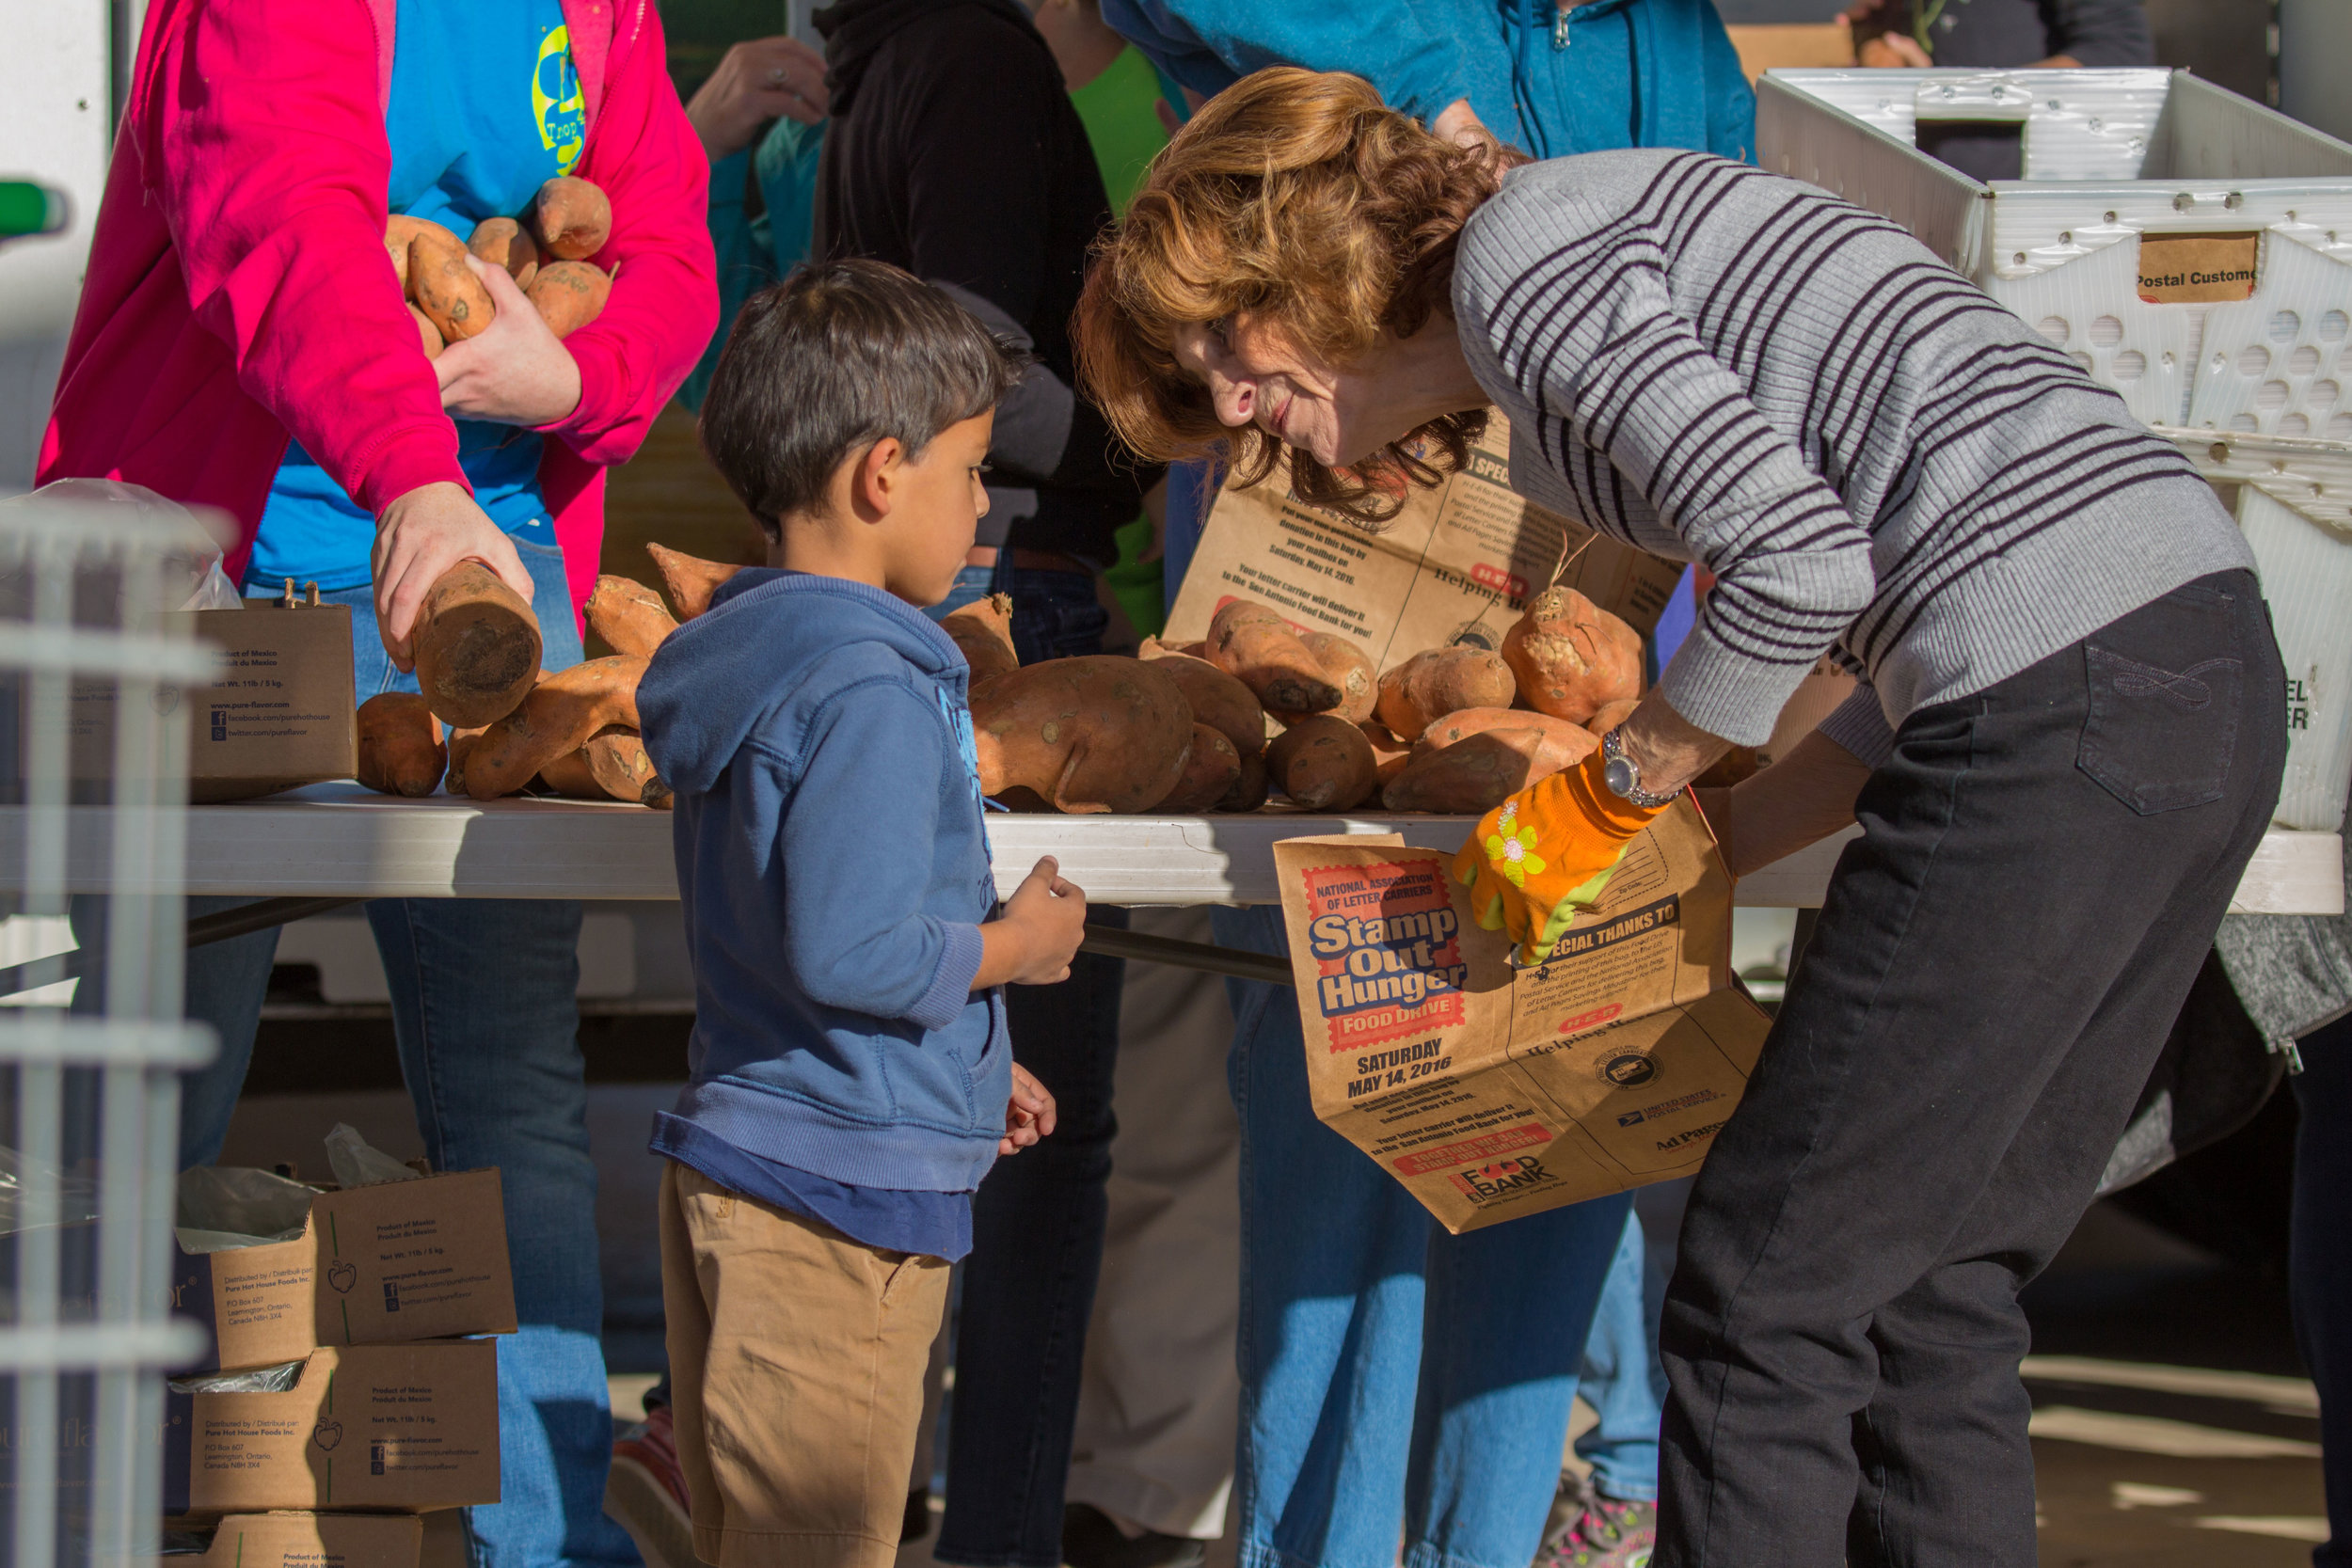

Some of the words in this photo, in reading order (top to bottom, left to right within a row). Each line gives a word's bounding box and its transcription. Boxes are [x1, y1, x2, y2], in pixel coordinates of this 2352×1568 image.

[2137, 272, 2185, 287] Postal
[1279, 519, 1314, 539] donation
[1316, 531, 1323, 542] in
[1325, 534, 1339, 548] this
[1340, 543, 1356, 556] bag
[1356, 548, 1367, 560] by
[1287, 537, 1306, 548] your
[1306, 545, 1337, 563] mailbox
[1338, 557, 1348, 567] on
[1306, 559, 1324, 573] May
[1239, 562, 1258, 578] Your
[1258, 571, 1281, 587] letter
[1282, 582, 1311, 599] carrier
[1312, 594, 1328, 607] will
[1328, 599, 1358, 617] deliver
[1359, 611, 1365, 622] it
[1435, 568, 1502, 608] Helping
[1222, 570, 1232, 580] to
[1232, 574, 1247, 586] the
[1248, 581, 1264, 594] San
[1264, 588, 1297, 609] Antonio
[1297, 601, 1317, 617] Food
[1318, 610, 1340, 626] Bank
[1341, 619, 1353, 630] for
[1354, 626, 1373, 640] you!
[1317, 880, 1367, 898] NATIONAL
[1370, 873, 1434, 888] ASSOCIATION
[1327, 899, 1341, 911] OF
[1344, 892, 1381, 908] LETTER
[1384, 884, 1433, 901] CARRIERS
[1312, 908, 1458, 954] Stamp
[1597, 913, 1654, 944] THANKS
[1655, 904, 1675, 924] TO
[1348, 940, 1435, 977] Out
[1520, 989, 1543, 1000] Postal
[1544, 982, 1569, 993] Service
[1599, 960, 1631, 975] National
[1632, 945, 1673, 965] Association
[1561, 967, 1590, 981] printing
[1321, 963, 1466, 1011] Hunger
[1535, 994, 1558, 1005] Letter
[1558, 985, 1586, 997] Carriers
[1343, 1013, 1392, 1034] FOOD
[1397, 999, 1450, 1023] DRIVE
[1358, 1037, 1442, 1074] SATURDAY
[1526, 1028, 1607, 1057] Helping
[1348, 1075, 1382, 1099] MAY
[1386, 1069, 1406, 1087] 14,
[1410, 1056, 1452, 1080] 2016
[1364, 1098, 1403, 1113] donation
[1386, 1105, 1406, 1114] your
[1406, 1094, 1442, 1107] mailbox
[1420, 1103, 1440, 1112] May
[1644, 1099, 1678, 1114] UNITED
[1679, 1089, 1711, 1104] STATES
[1646, 1106, 1681, 1120] POSTAL
[1683, 1094, 1719, 1109] SERVICE
[1375, 1135, 1398, 1145] Your
[1396, 1129, 1423, 1139] letter
[1423, 1120, 1455, 1132] carrier
[1455, 1114, 1474, 1124] will
[1473, 1106, 1505, 1119] deliver
[1382, 1144, 1399, 1152] the
[1399, 1139, 1419, 1148] San
[1418, 1131, 1454, 1143] Antonio
[1453, 1123, 1478, 1134] Food
[1475, 1117, 1501, 1129] Bank
[1499, 1114, 1514, 1122] for
[1412, 1143, 1476, 1163] TOGETHER
[1474, 1136, 1498, 1148] WE
[1497, 1130, 1525, 1142] CAN
[1413, 1155, 1456, 1171] STAMP
[1457, 1149, 1484, 1161] OUT
[1485, 1134, 1540, 1154] HUNGER!
[1656, 1136, 1679, 1151] Ad
[1474, 1165, 1556, 1197] BANK
[229, 1317, 252, 1325] Canada
